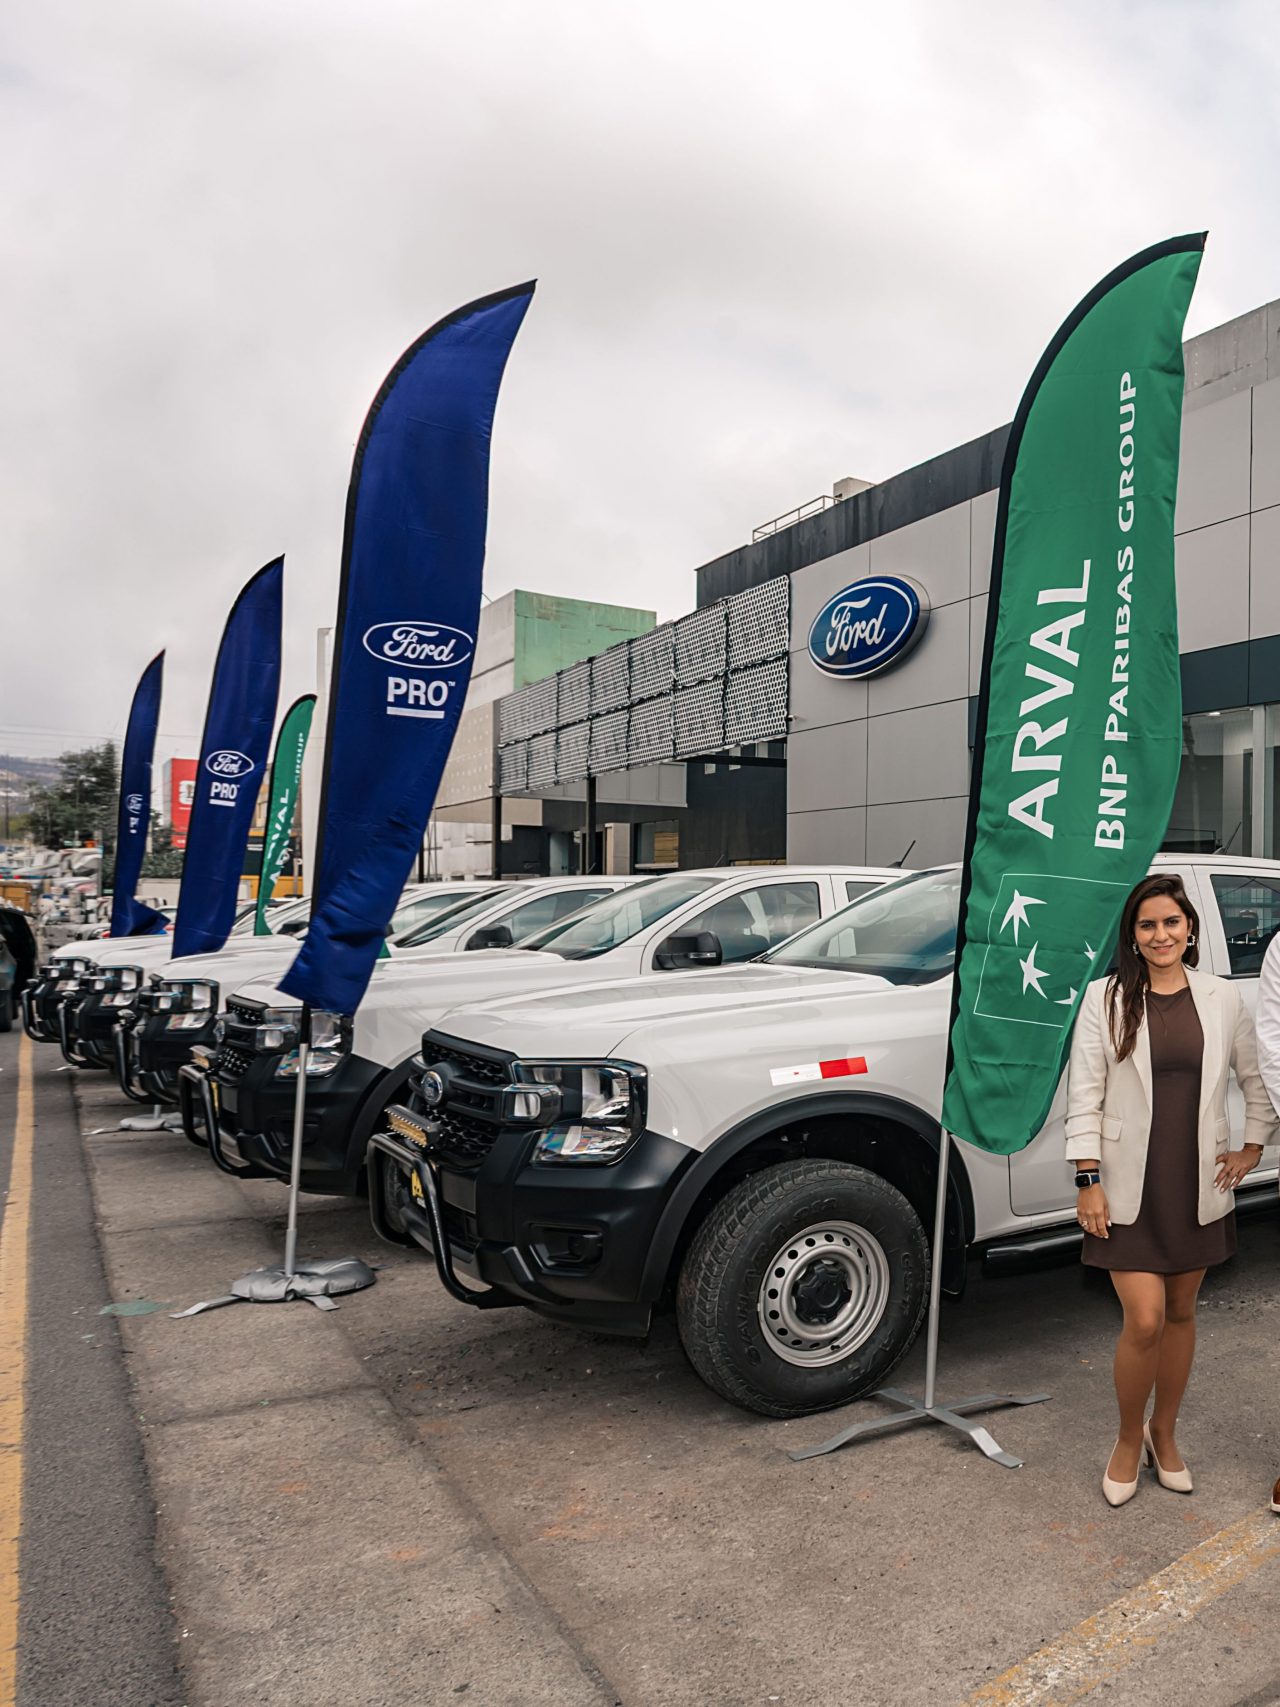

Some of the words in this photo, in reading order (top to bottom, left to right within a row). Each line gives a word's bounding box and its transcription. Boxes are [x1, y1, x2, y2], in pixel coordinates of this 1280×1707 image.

[1117, 371, 1137, 533] GROUP
[383, 626, 457, 662] Ford
[826, 595, 888, 657] Ford
[1103, 545, 1135, 742] PARIBAS
[1007, 558, 1092, 839] ARVAL
[1094, 754, 1128, 851] BNP
